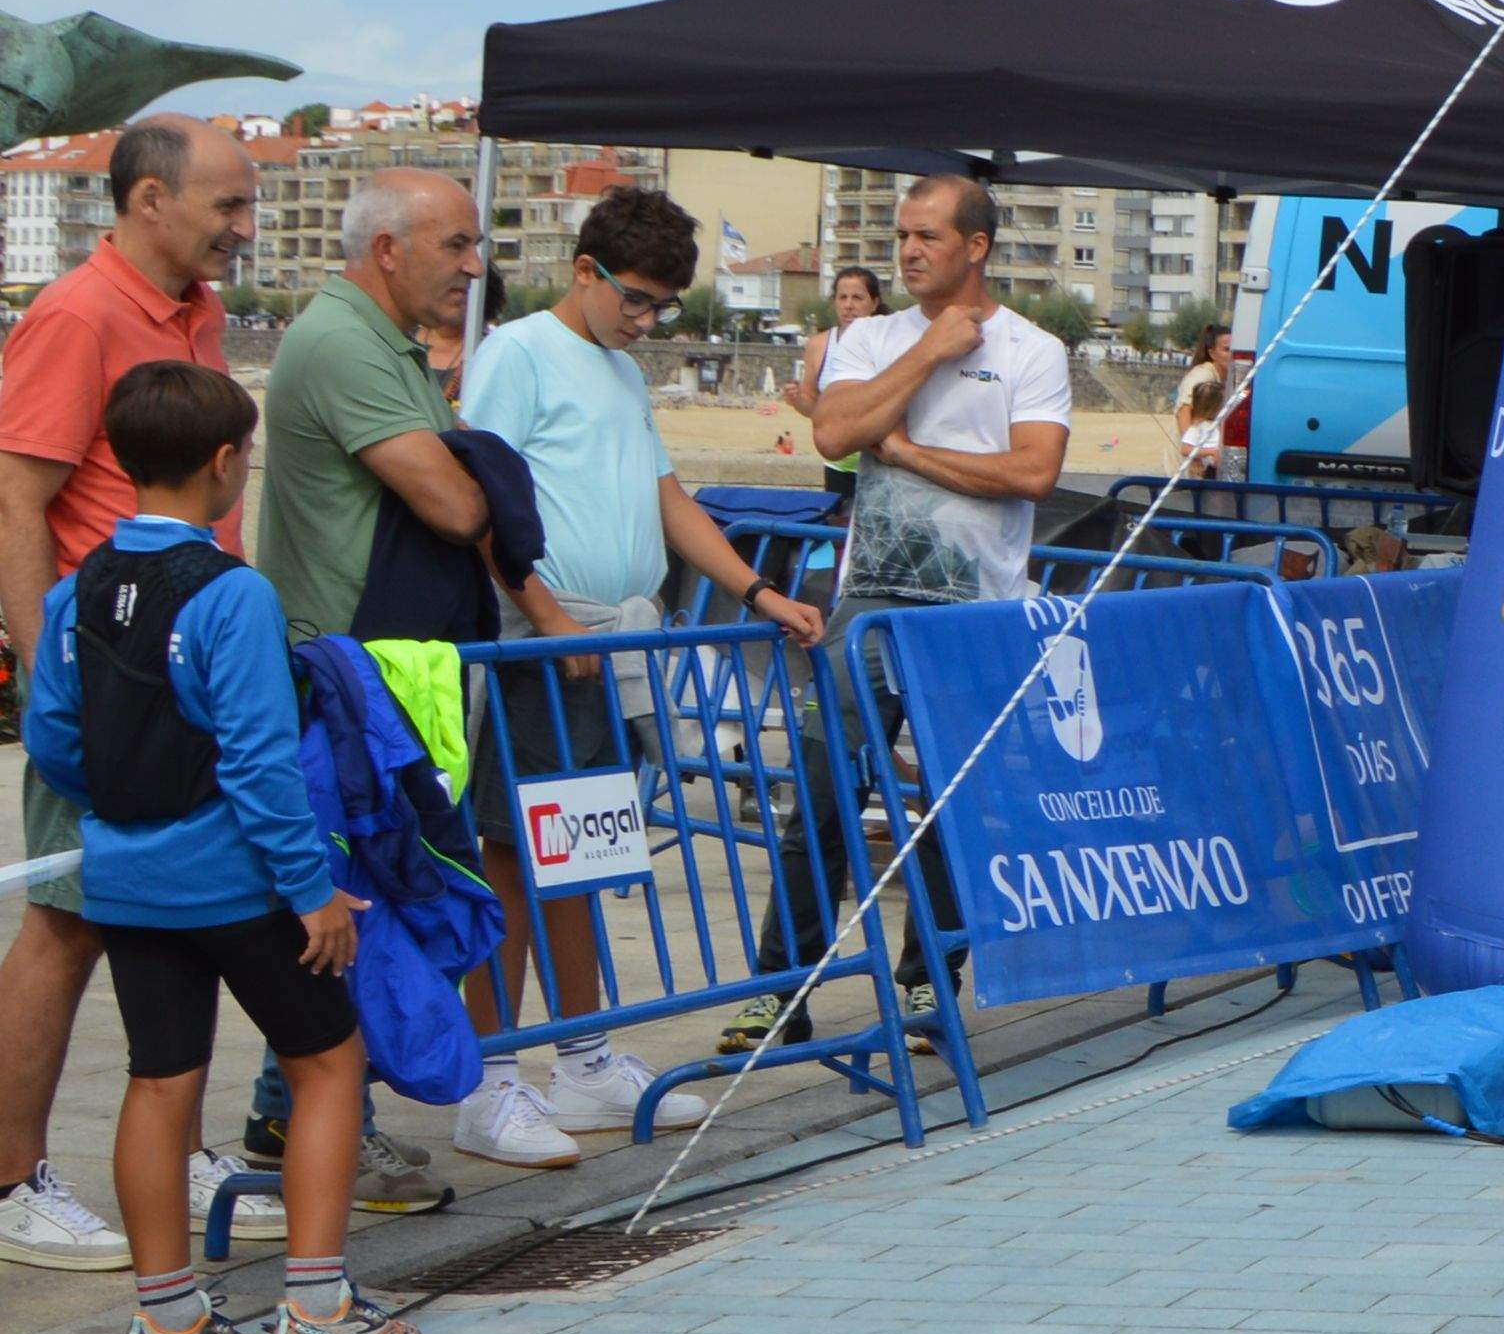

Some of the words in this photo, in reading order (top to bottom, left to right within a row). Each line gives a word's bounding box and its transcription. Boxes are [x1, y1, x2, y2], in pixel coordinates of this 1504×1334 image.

[1318, 461, 1406, 475] MASTER
[1296, 618, 1384, 709] 365
[1038, 787, 1135, 822] CONCELLO
[1135, 785, 1166, 816] DE
[989, 835, 1249, 933] SANXENXO
